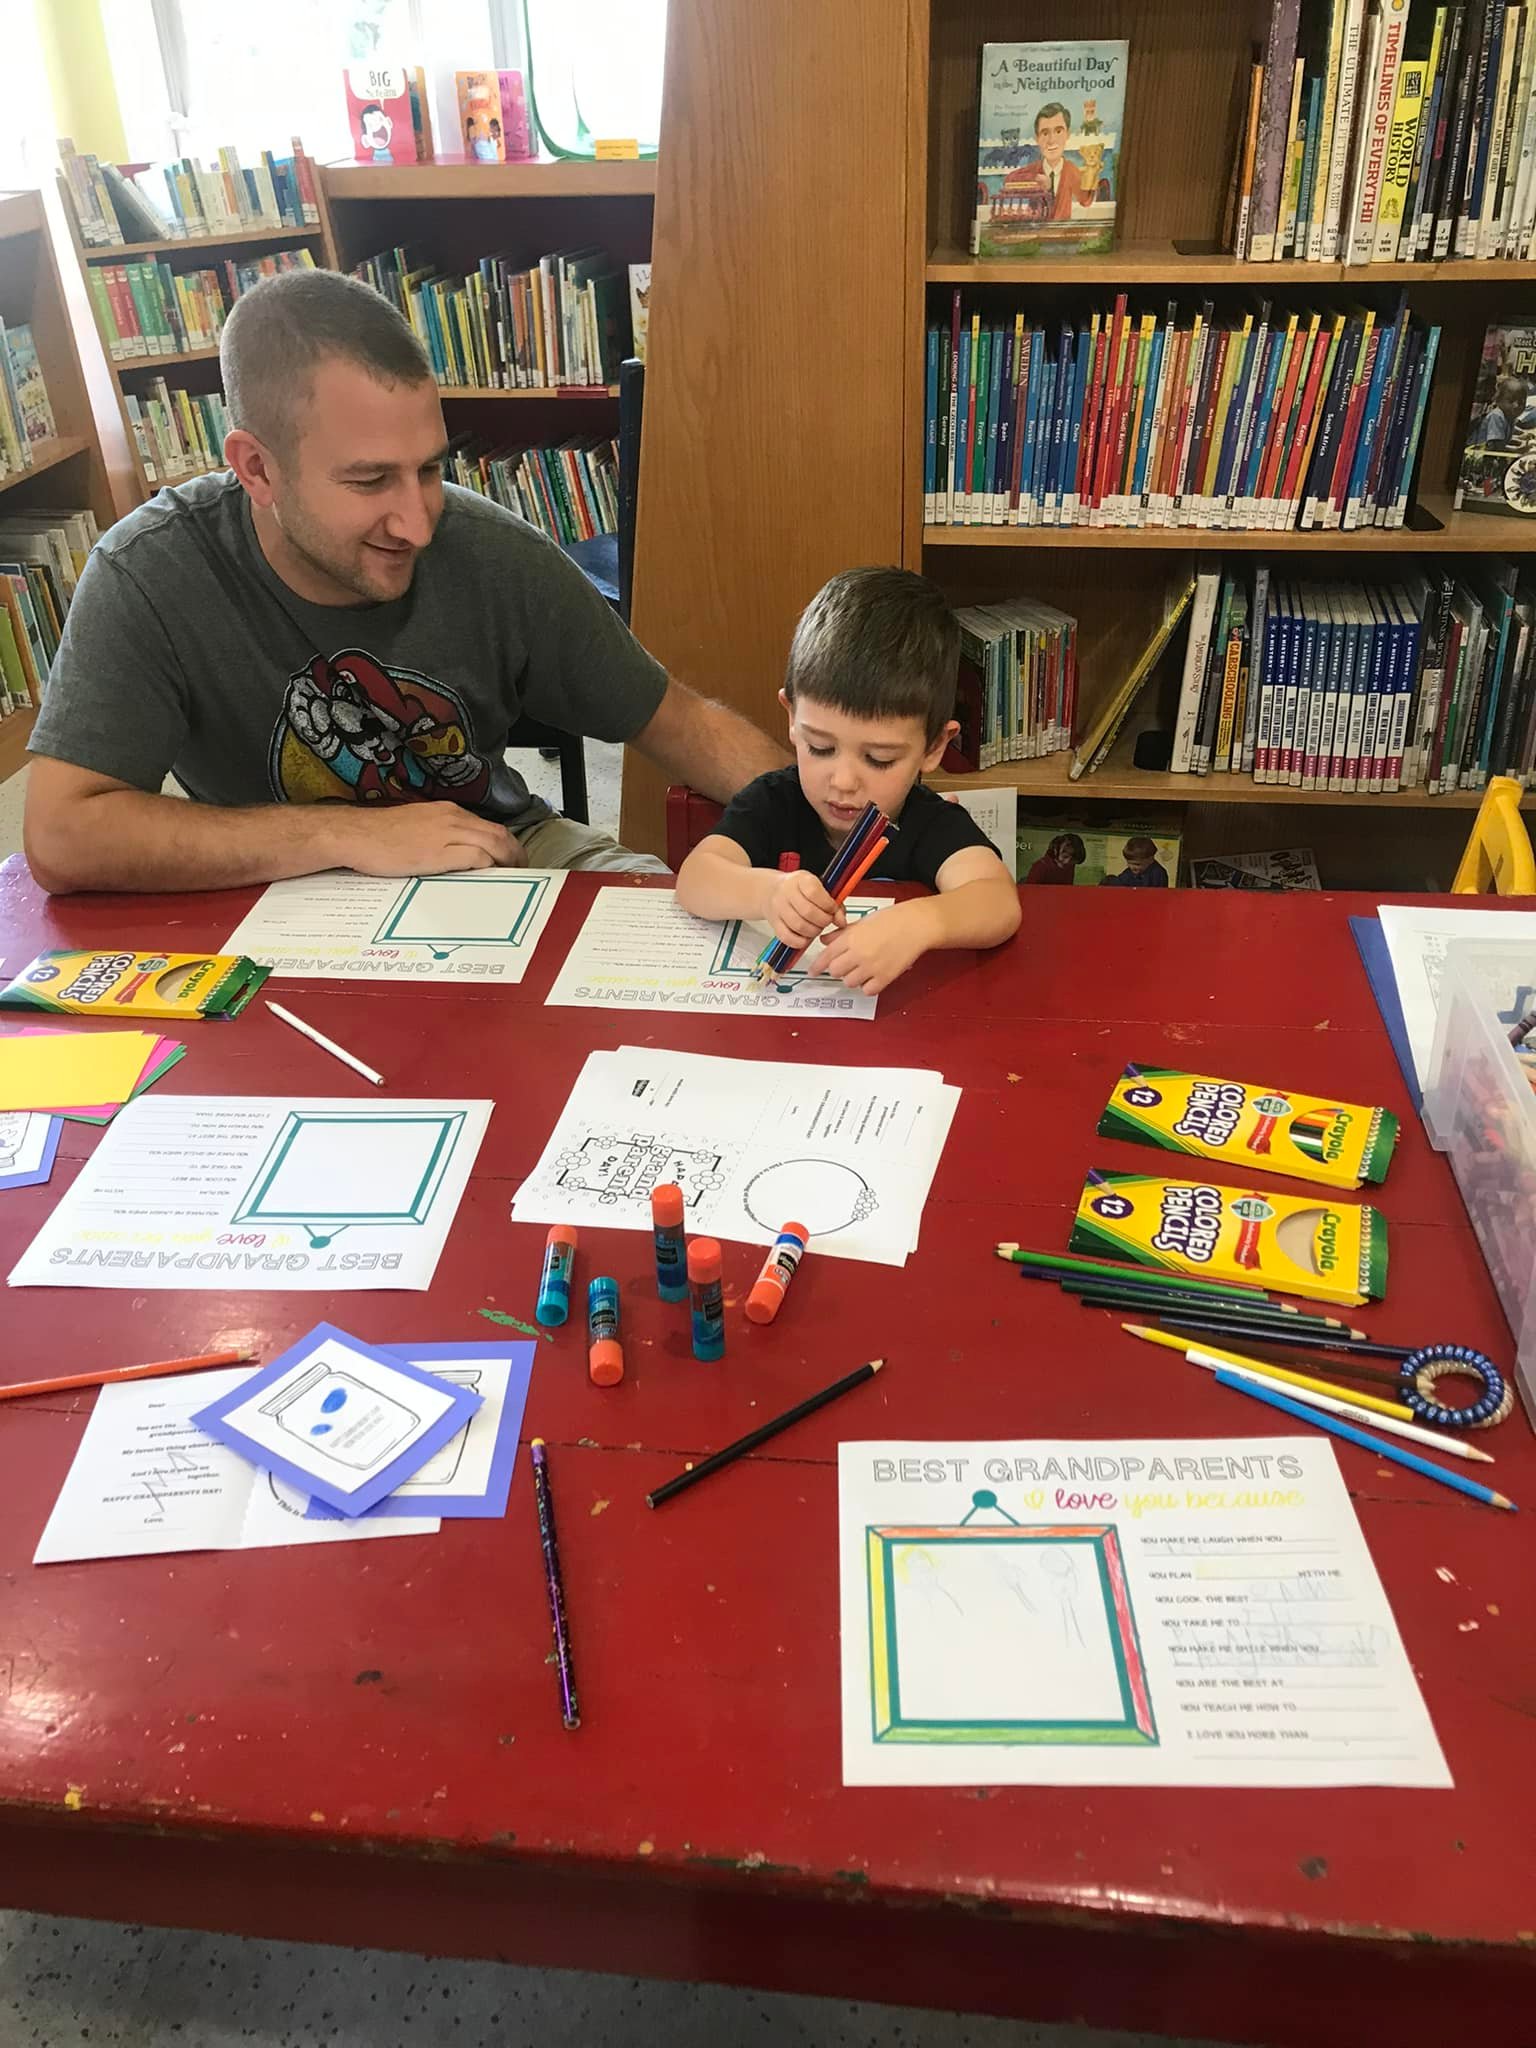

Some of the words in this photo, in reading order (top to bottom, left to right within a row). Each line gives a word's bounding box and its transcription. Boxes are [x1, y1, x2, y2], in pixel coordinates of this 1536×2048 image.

[1492, 1, 1505, 39] TITANIC
[1347, 23, 1359, 50] THE
[369, 71, 391, 87] BIG
[991, 60, 1008, 77] A
[1013, 58, 1081, 73] Beautiful
[1086, 57, 1118, 73] Day
[1377, 20, 1401, 111] TIMELINES
[1012, 75, 1115, 94] Neighborhood
[1339, 56, 1355, 123] ULTIMATE
[1373, 112, 1388, 134] OF
[1334, 127, 1347, 167] PETER
[1384, 121, 1404, 184] HISTORY
[1394, 115, 1418, 188] WORLD
[1329, 172, 1342, 210] RABBI
[1018, 338, 1031, 386] SWEDEN
[1358, 334, 1381, 389] CANADA
[951, 382, 956, 392] AT
[939, 415, 948, 446] Germany
[959, 418, 967, 442] Poland
[1054, 418, 1063, 443] Greece
[1185, 405, 1196, 427] IRAQ
[1323, 412, 1335, 434] South
[1000, 421, 1008, 441] Spain
[1071, 422, 1080, 442] China
[1140, 417, 1151, 448] Pakistan
[1255, 420, 1268, 449] Vietnam
[1273, 421, 1287, 448] Nigeria
[1295, 423, 1308, 447] Kenya
[1318, 434, 1330, 457] Africa
[1362, 417, 1375, 446] Canada
[1345, 647, 1353, 675] HISTORY
[1374, 646, 1383, 675] HISTORY
[1403, 645, 1411, 674] HISTORY
[1220, 642, 1241, 719] CARSCHOOLING
[257, 957, 434, 973] GRANDPAREN
[361, 949, 400, 959] love
[31, 968, 51, 980] 12
[59, 955, 109, 1000] PENCILS
[80, 953, 136, 1003] COLORED
[177, 962, 217, 999] Crayola
[440, 963, 505, 975] BEST
[574, 986, 780, 1008] GRANDPARENTS
[702, 980, 741, 991] love
[787, 997, 855, 1009] BEST
[1132, 1089, 1153, 1104] 12
[1175, 1082, 1211, 1136] PENCILS
[1205, 1084, 1245, 1146] COLORED
[1325, 1113, 1354, 1161] Crayola
[598, 1133, 655, 1204] parents
[627, 1144, 674, 1201] grand
[1101, 1198, 1124, 1215] 12
[1152, 1187, 1192, 1251] PENCILS
[1187, 1187, 1221, 1262] COLORED
[216, 1234, 266, 1248] love
[1320, 1212, 1341, 1271] Crayola
[49, 1247, 311, 1271] GRANDPARENTS
[315, 1253, 403, 1272] BEST
[872, 1458, 970, 1484] BEST
[983, 1455, 1304, 1483] GRANDPARENTS
[1055, 1487, 1118, 1510] love
[1124, 1490, 1179, 1518] you
[1184, 1487, 1304, 1510] because
